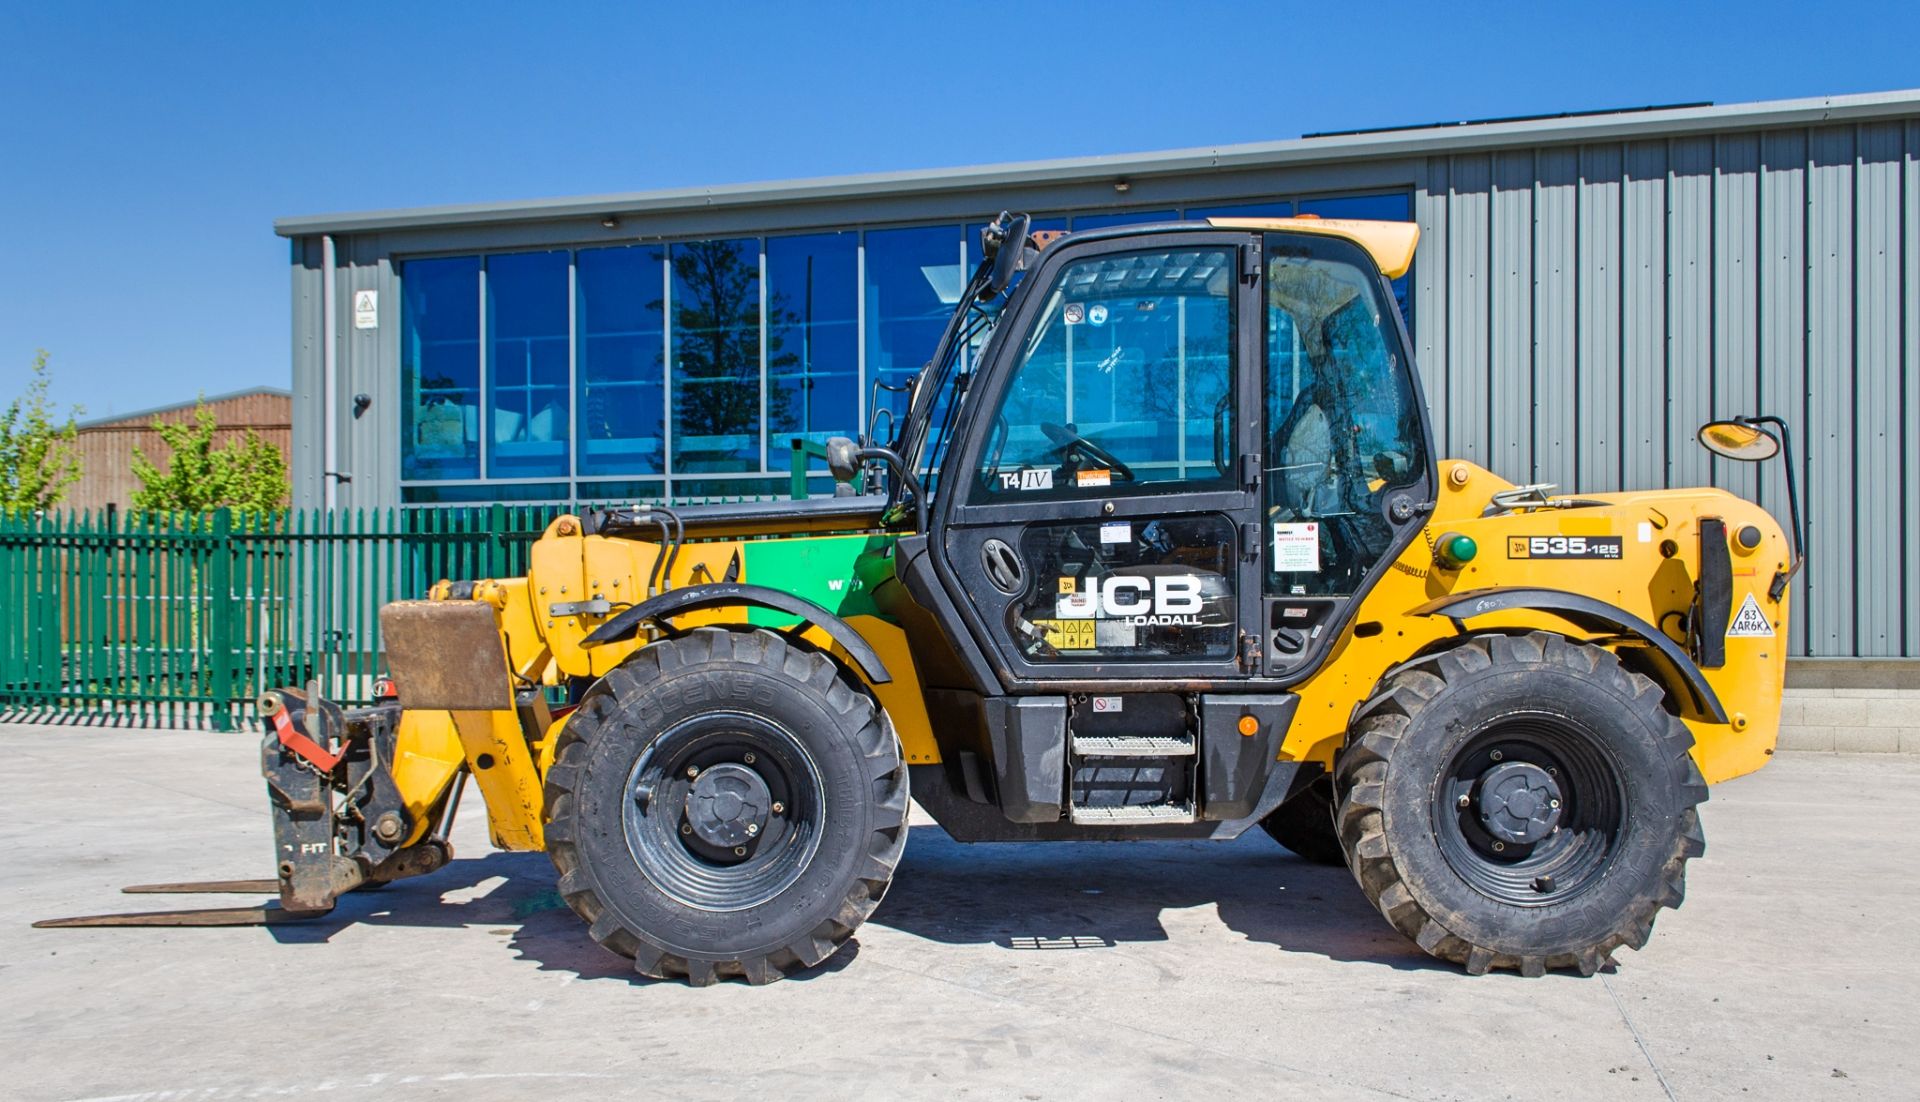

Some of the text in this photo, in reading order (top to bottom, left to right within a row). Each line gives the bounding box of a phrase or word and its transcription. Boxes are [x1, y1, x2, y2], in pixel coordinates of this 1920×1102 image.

[999, 471, 1048, 489] T4 IV
[1530, 537, 1619, 554] 535-125
[1059, 576, 1203, 615] JCB
[1125, 615, 1203, 627] LOADALL
[1744, 610, 1757, 620] 83
[1737, 621, 1763, 631] AR6K
